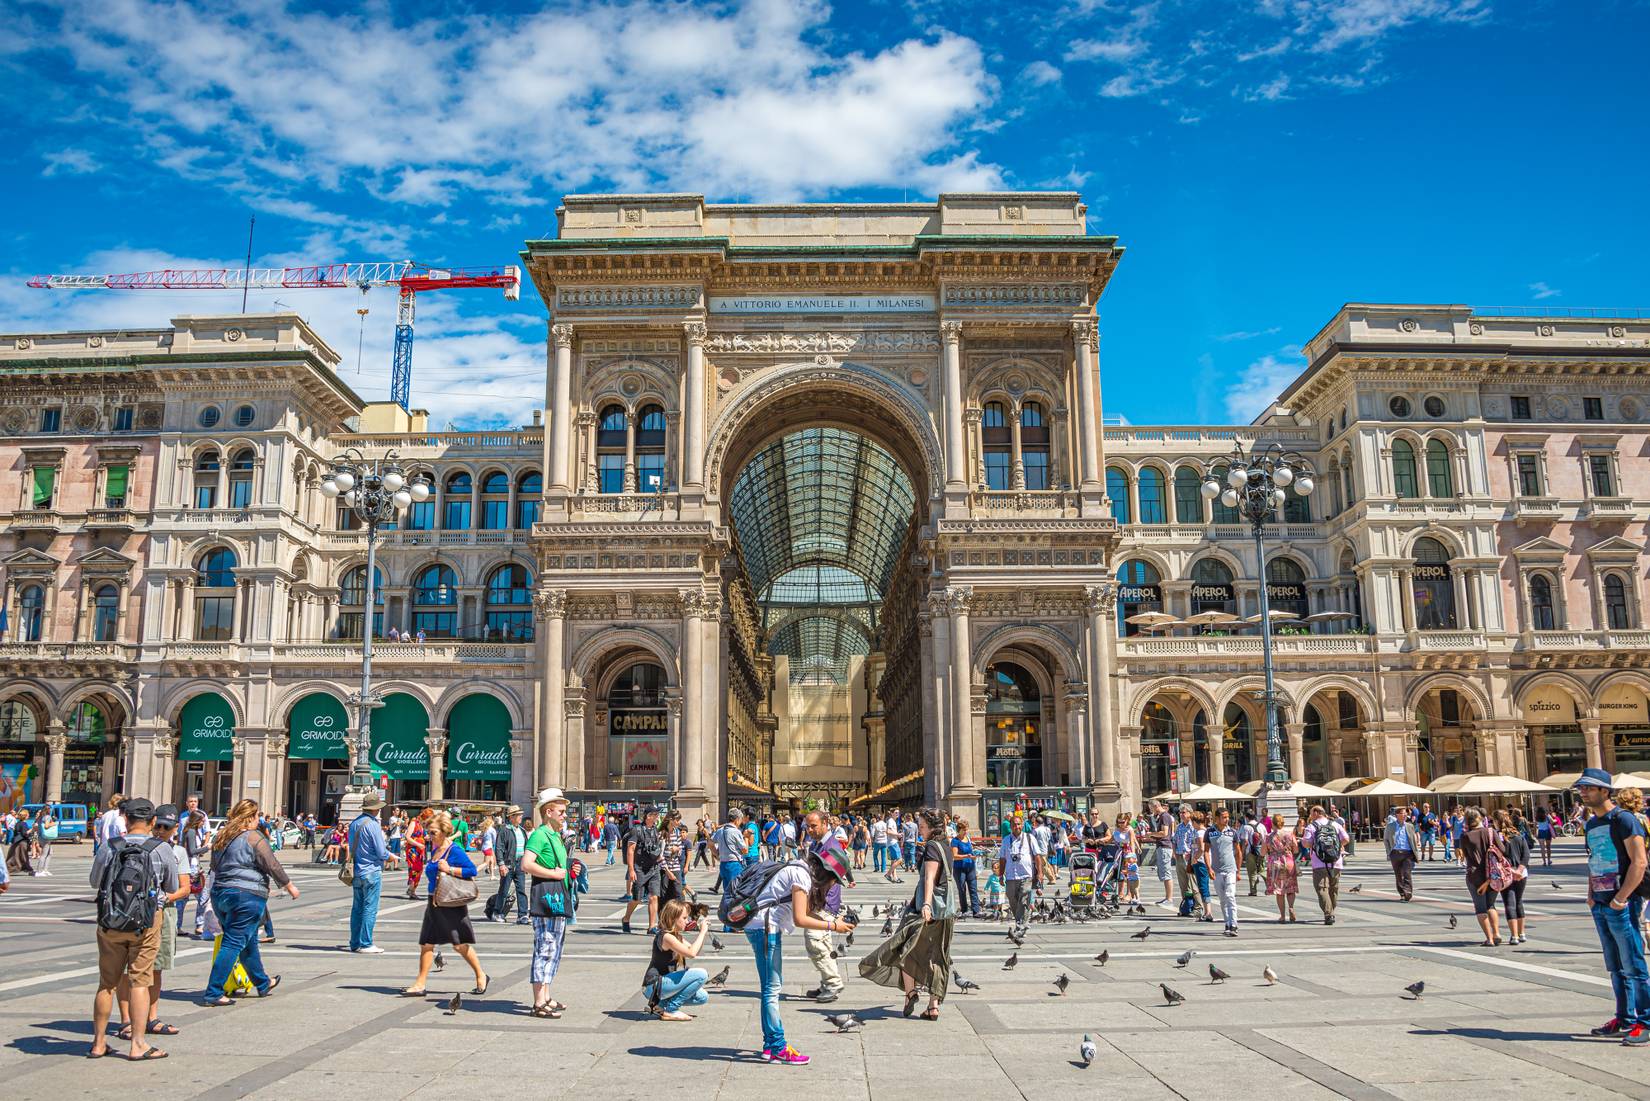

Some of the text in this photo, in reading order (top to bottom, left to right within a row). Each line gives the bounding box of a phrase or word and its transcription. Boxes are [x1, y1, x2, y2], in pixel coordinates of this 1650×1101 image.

[720, 300, 727, 308] A
[734, 300, 781, 308] VITTORIO
[787, 300, 844, 308] EMANUELE
[877, 299, 924, 308] MILANESI
[1410, 566, 1446, 576] APEROL
[1119, 586, 1156, 597] APEROL
[1192, 586, 1228, 597] APEROL
[1266, 585, 1300, 596] APEROL
[1529, 700, 1560, 712] spizzico
[613, 715, 667, 729] CAMPAR
[301, 730, 345, 740] GRIMOLDI
[375, 741, 427, 764] Currado
[456, 741, 508, 764] Currado
